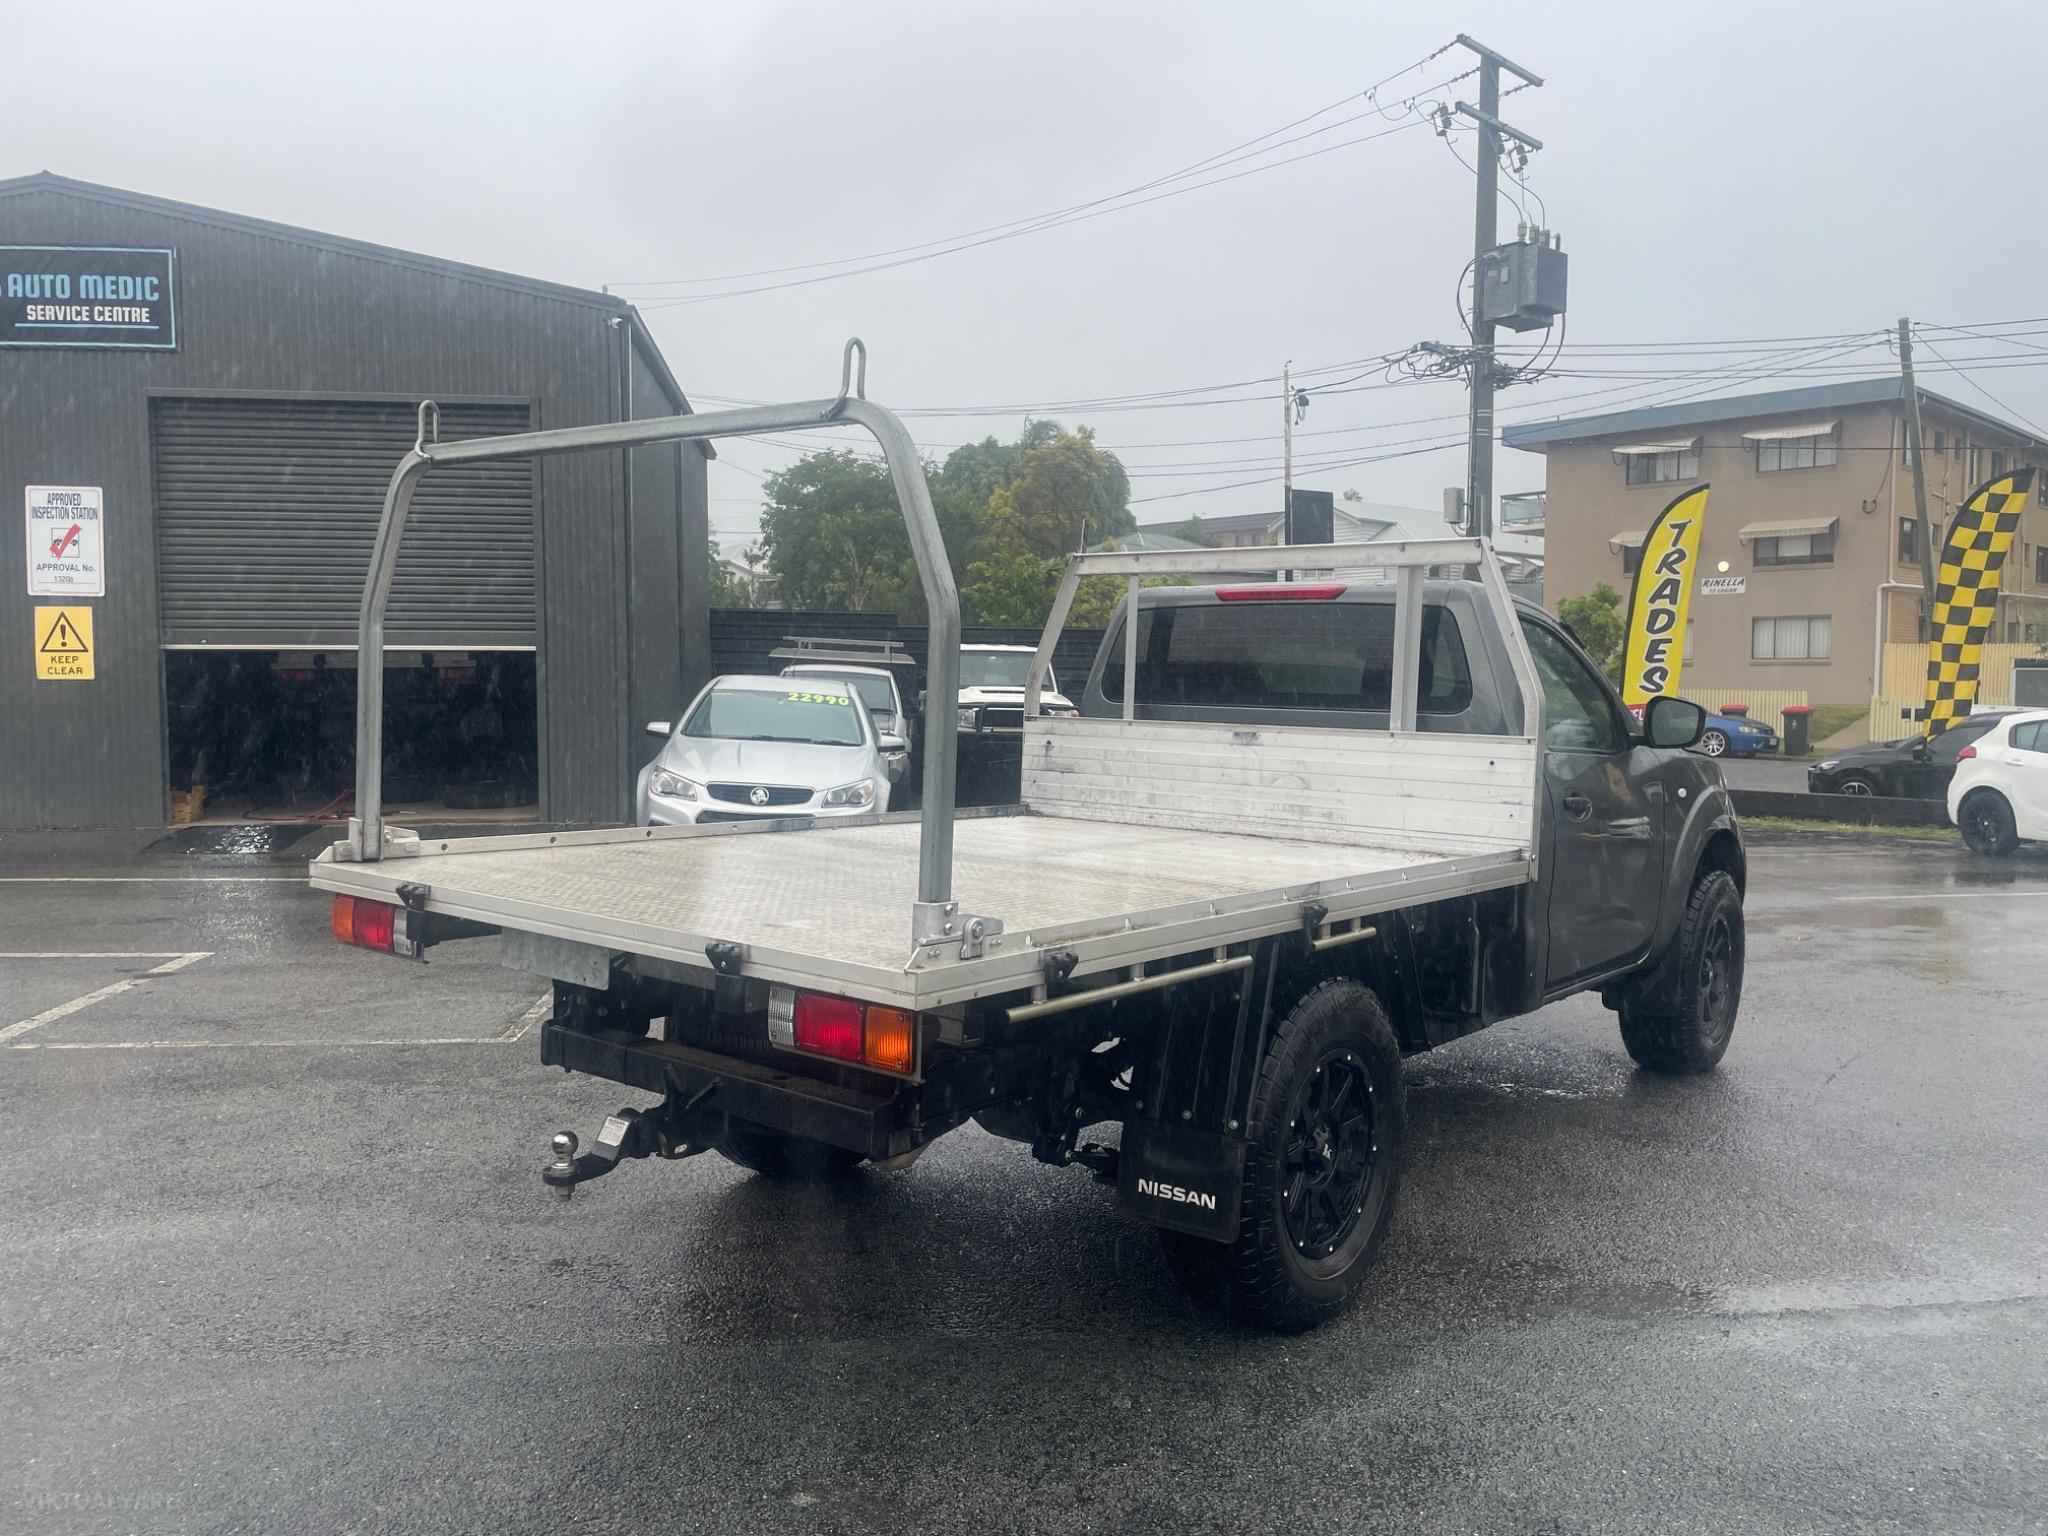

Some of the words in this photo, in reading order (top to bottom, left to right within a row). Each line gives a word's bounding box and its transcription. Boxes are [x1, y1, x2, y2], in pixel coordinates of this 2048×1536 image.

[7, 273, 71, 299] AUTO
[79, 275, 160, 302] MEDIC
[26, 304, 91, 321] SERVICE
[93, 306, 151, 323] CENTRE
[46, 493, 82, 506] APPROVED
[31, 506, 71, 520] INSPECTION
[71, 507, 99, 520] STATION
[36, 563, 81, 572] APPROVAL
[1702, 578, 1745, 588] RINELLA
[1638, 518, 1692, 694] TRADES
[50, 655, 79, 664] KEEP
[47, 666, 84, 675] CLEAR
[788, 692, 849, 706] 22990
[1137, 1178, 1216, 1210] NISSAN
